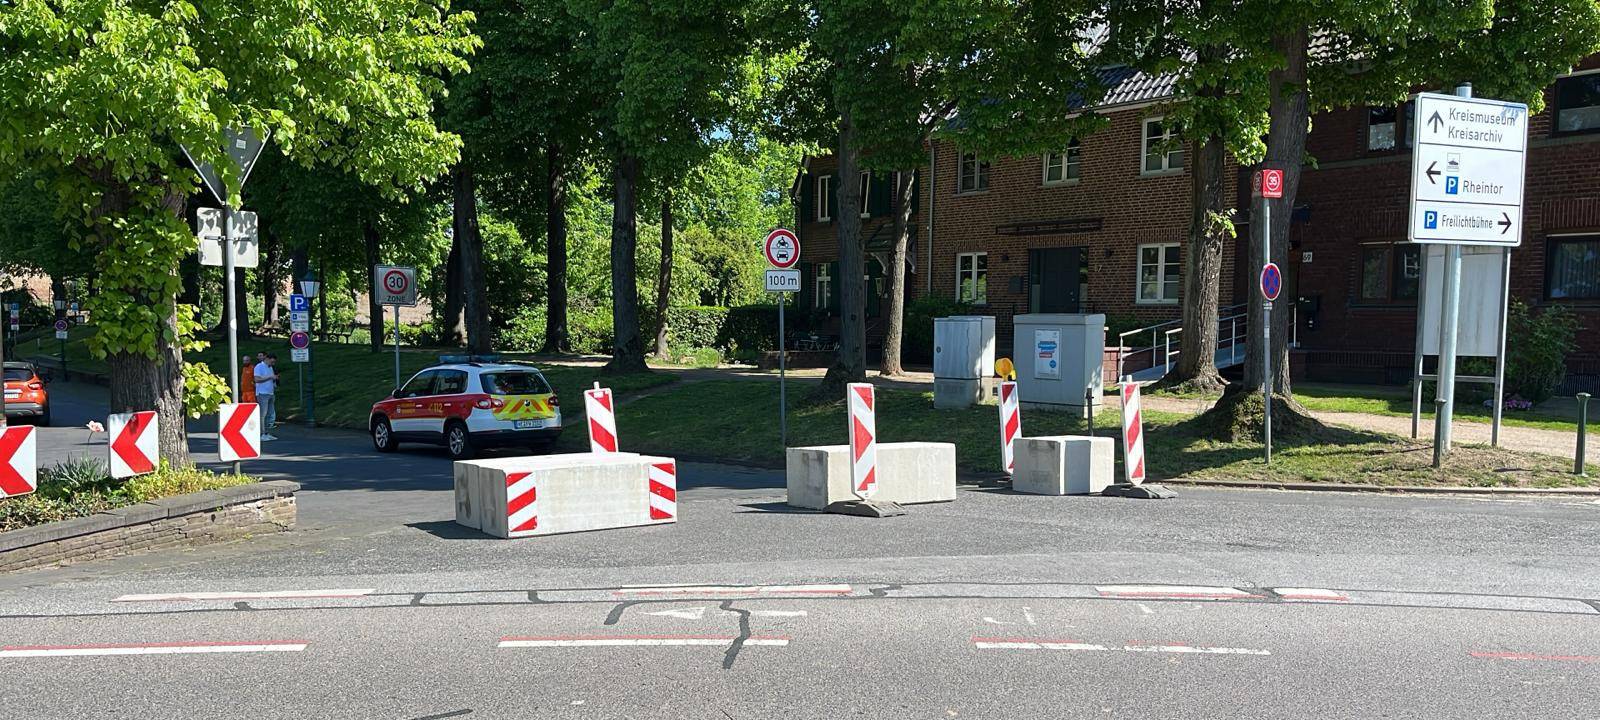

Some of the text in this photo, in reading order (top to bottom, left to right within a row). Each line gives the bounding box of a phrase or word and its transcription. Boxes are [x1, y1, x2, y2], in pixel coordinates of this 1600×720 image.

[1449, 107, 1516, 127] Kreismuseum
[1448, 126, 1503, 143] Kreisarchiv
[1268, 176, 1278, 187] 35
[1447, 178, 1504, 195] P Rheintor
[1426, 212, 1493, 229] P Freilichtbühne
[389, 276, 403, 288] 30
[769, 276, 797, 285] 100 m
[294, 297, 304, 309] P
[387, 295, 406, 303] ZONE
